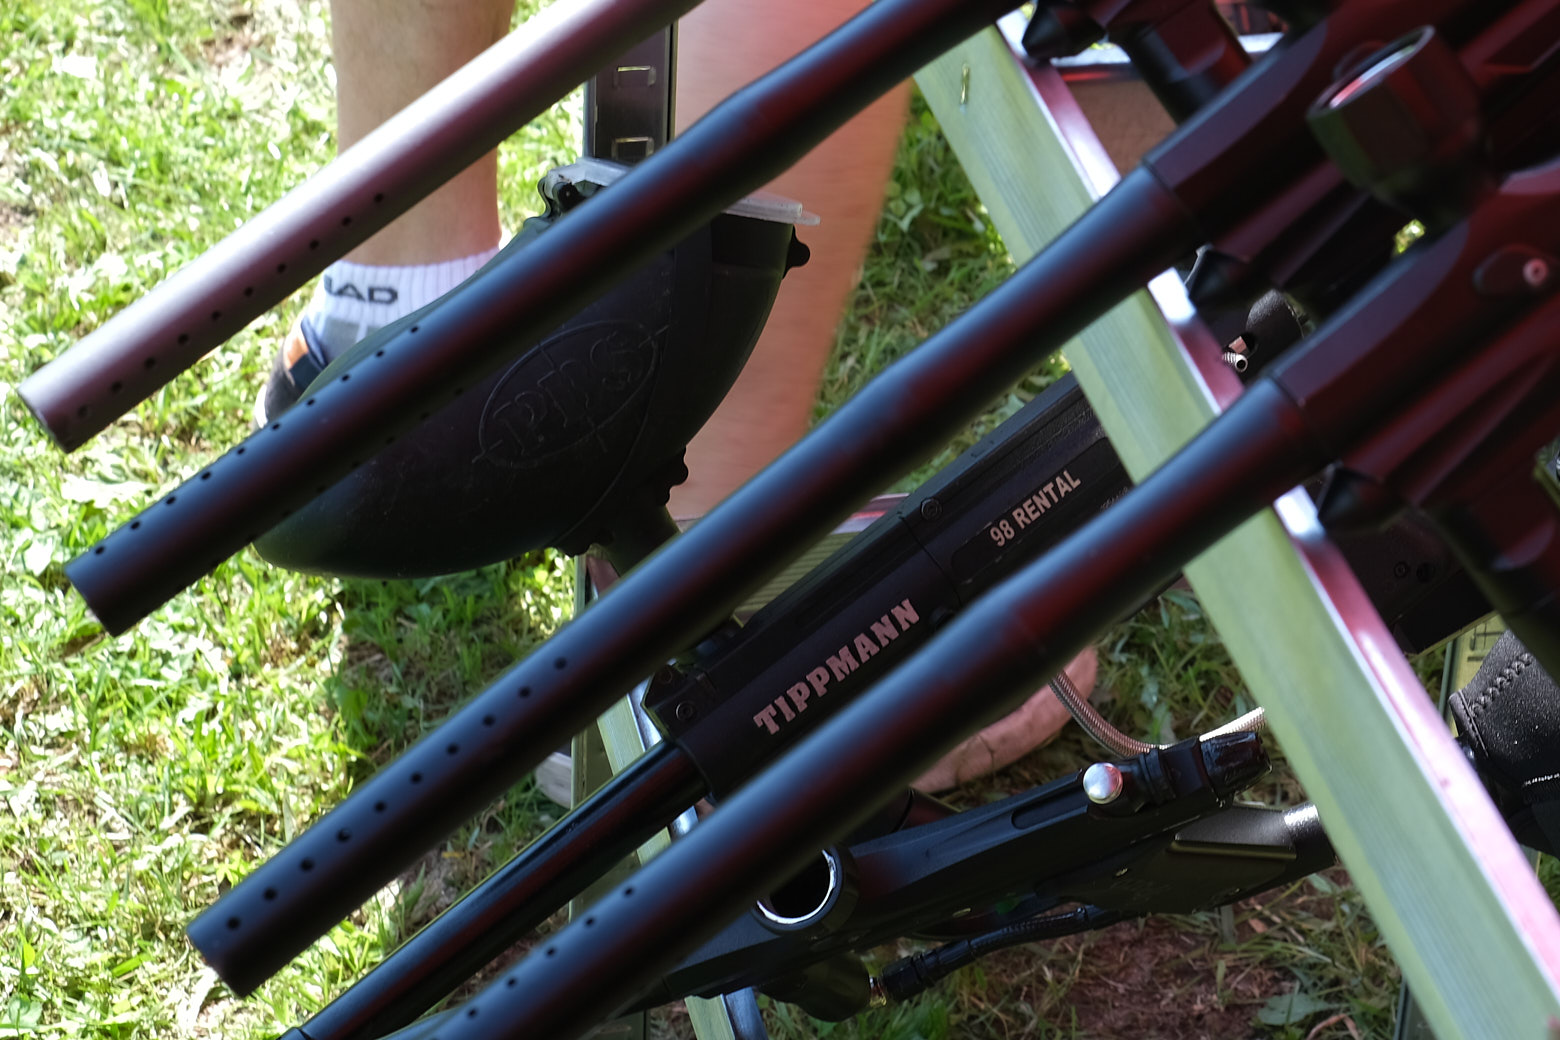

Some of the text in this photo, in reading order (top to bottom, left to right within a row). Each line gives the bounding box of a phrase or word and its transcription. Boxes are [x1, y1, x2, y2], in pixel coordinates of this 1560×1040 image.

[989, 519, 1015, 547] 98
[1011, 469, 1082, 530] RENTAL
[752, 596, 922, 737] TIPPMANN
